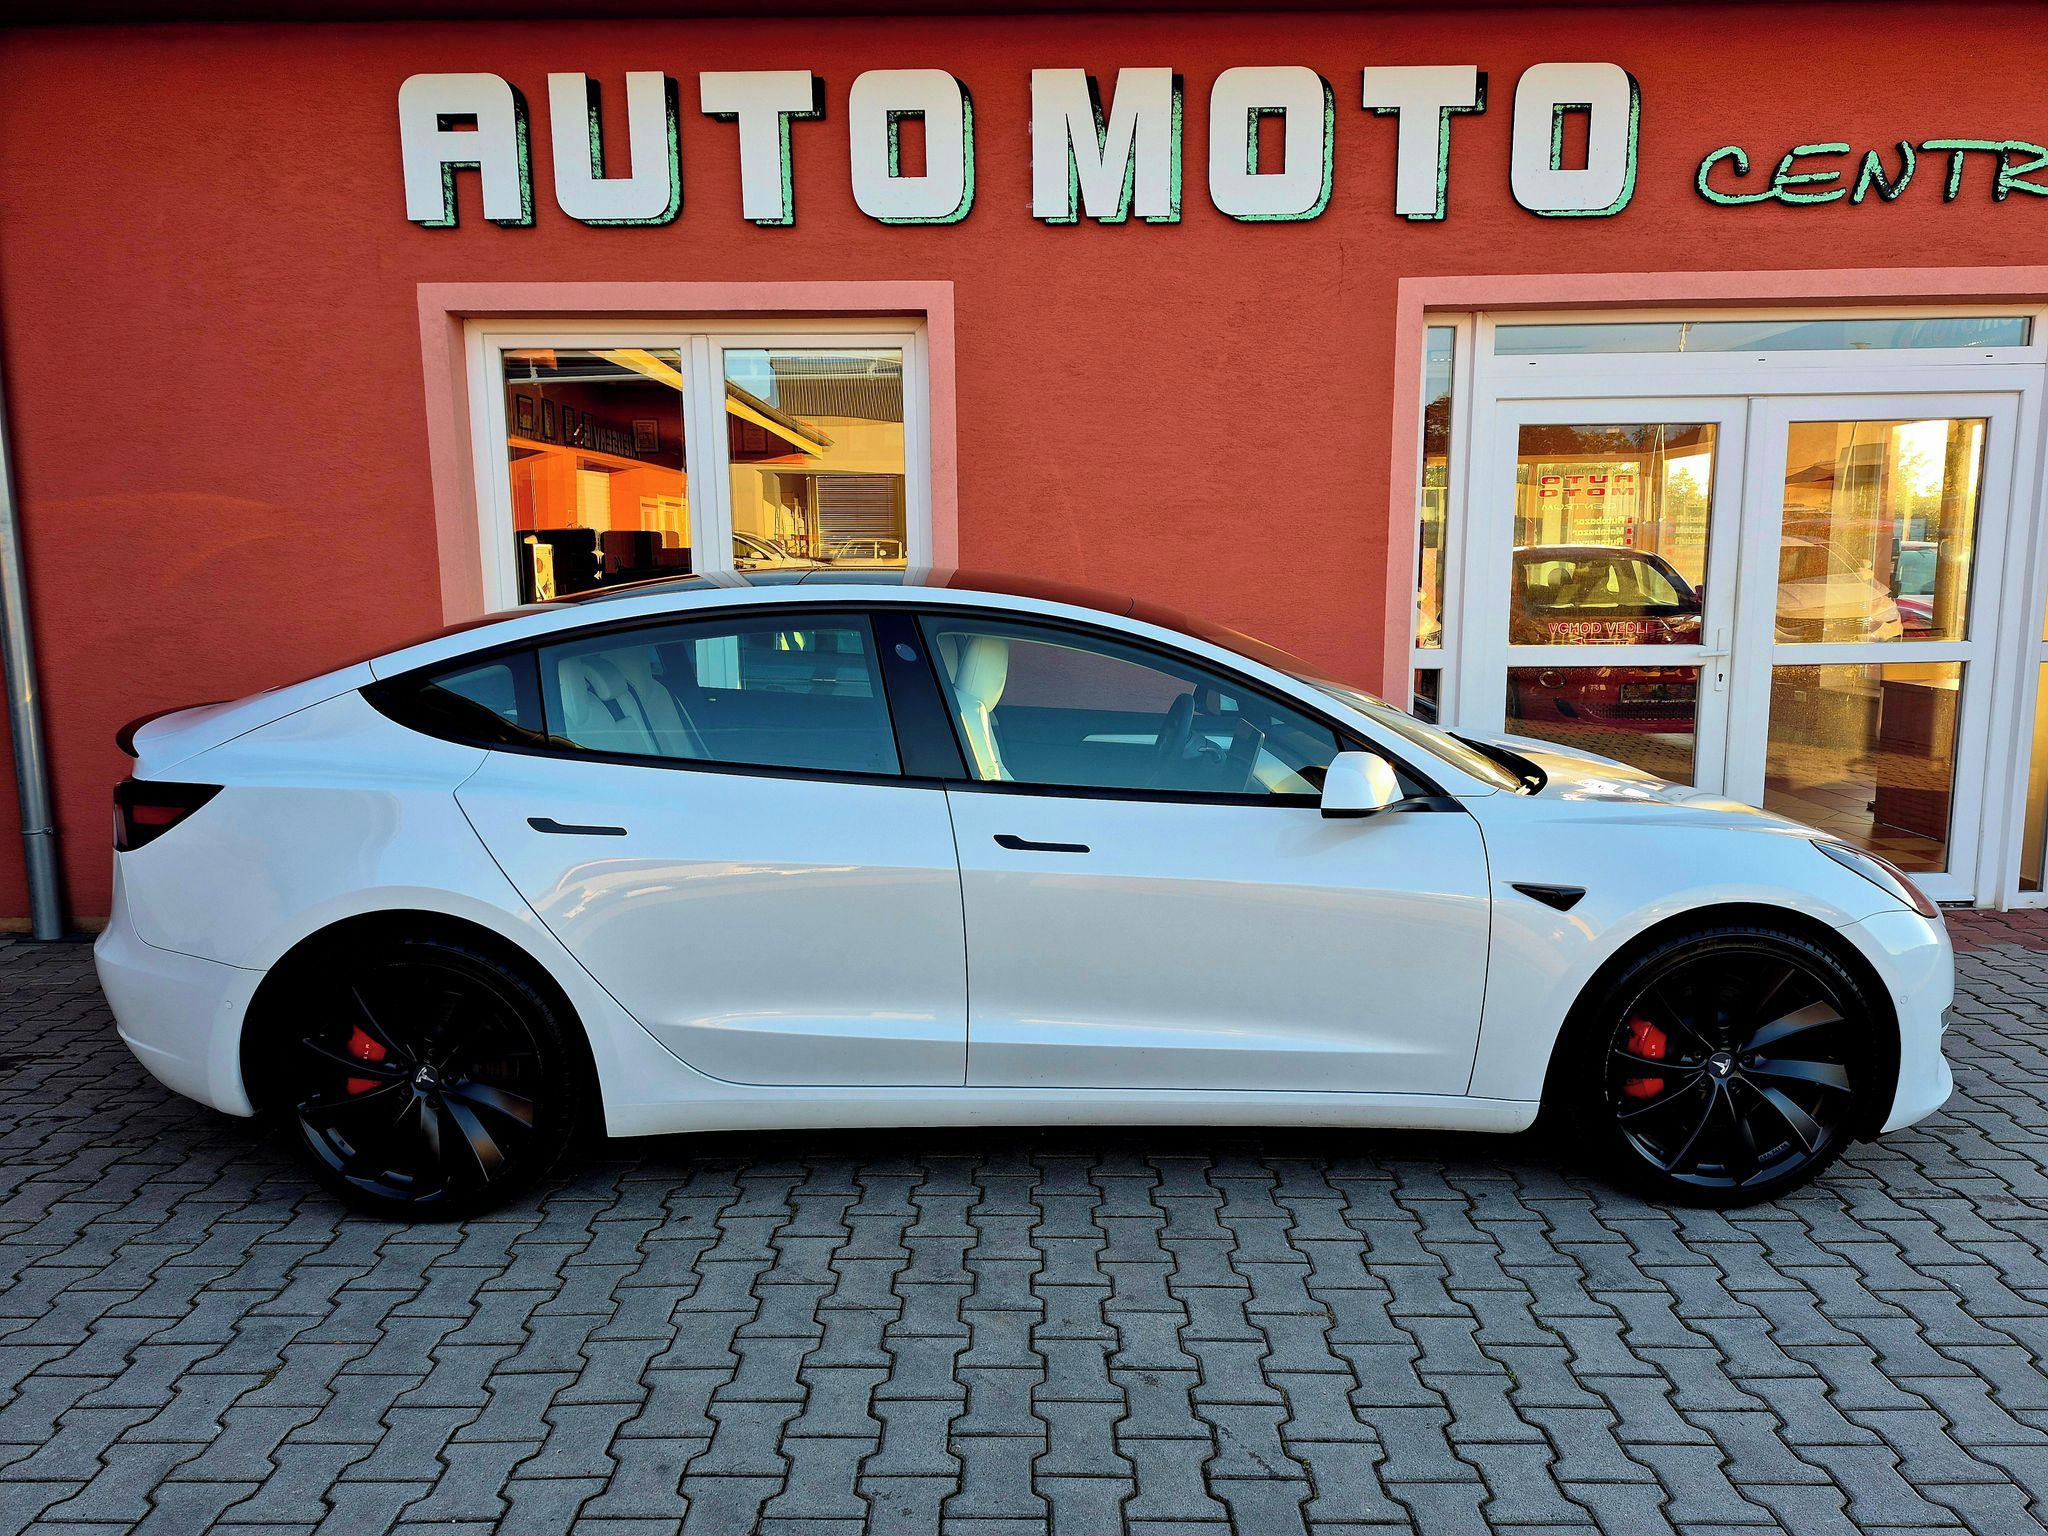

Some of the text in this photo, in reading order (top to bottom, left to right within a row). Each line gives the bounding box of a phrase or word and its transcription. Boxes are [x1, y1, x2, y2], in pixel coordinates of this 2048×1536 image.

[398, 62, 2048, 228] AUTO MOTO CENTR
[1548, 621, 1602, 635] VCHOD
